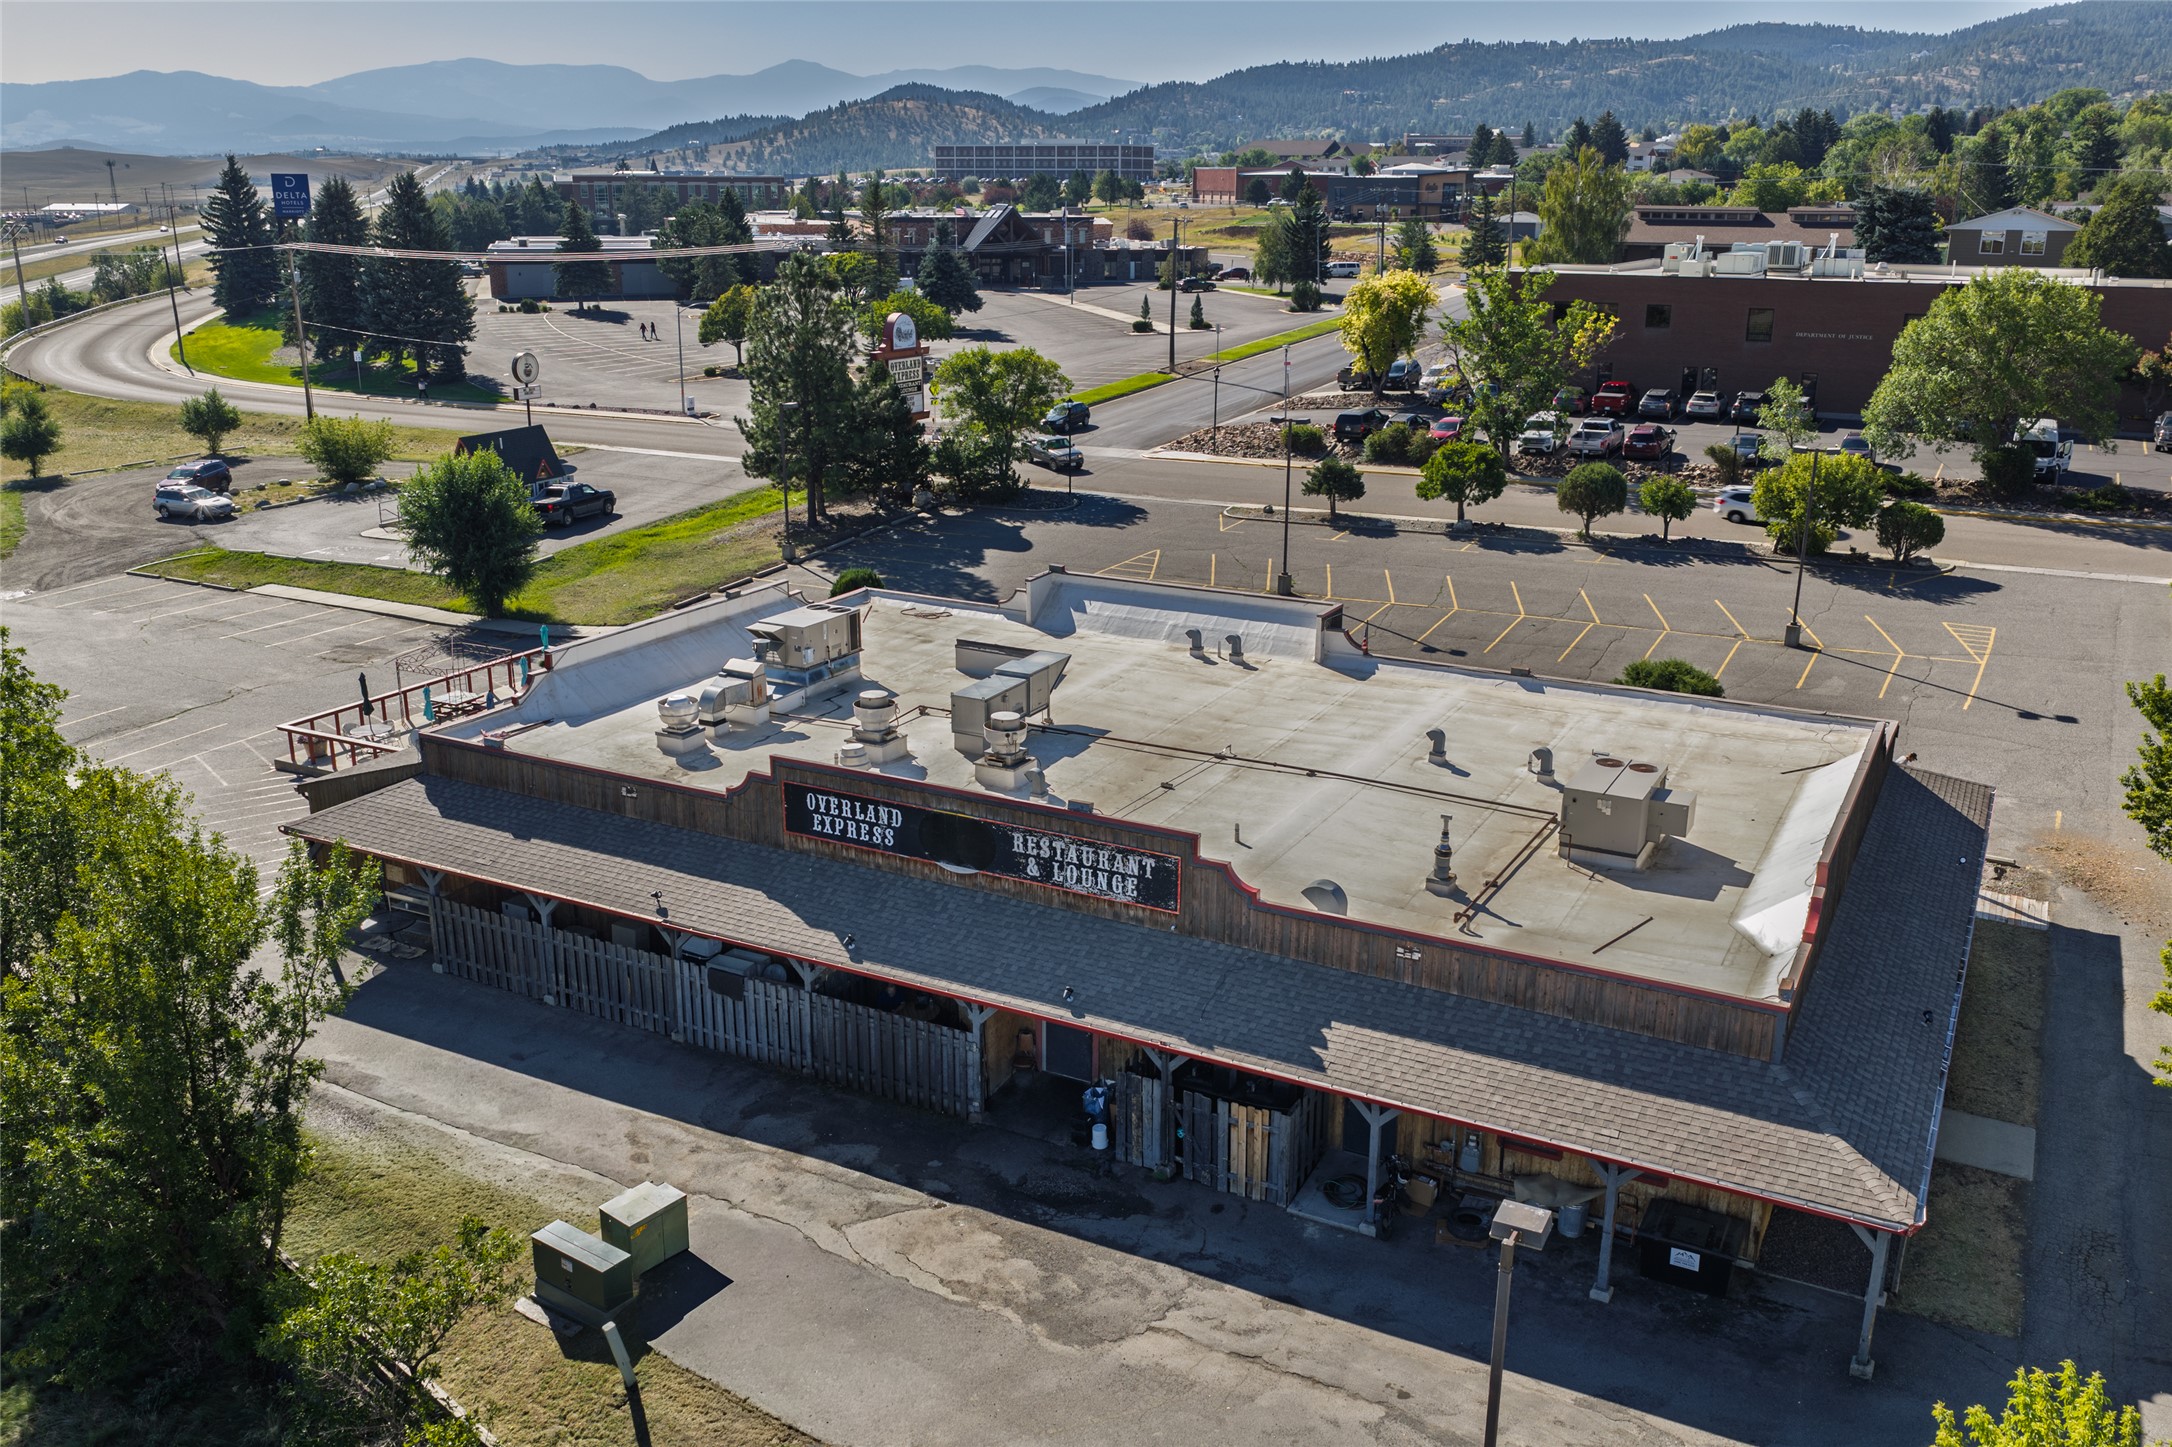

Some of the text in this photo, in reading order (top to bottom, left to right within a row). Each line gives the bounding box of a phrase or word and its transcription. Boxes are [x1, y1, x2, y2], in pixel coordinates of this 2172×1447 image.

[275, 191, 308, 200] DELTA
[890, 359, 921, 372] OVERLAND
[806, 792, 903, 828] OVERLAND
[812, 813, 894, 847] EXPRESS
[1011, 832, 1156, 879] RESTAURANT
[1026, 856, 1138, 898] & LOUNGE
